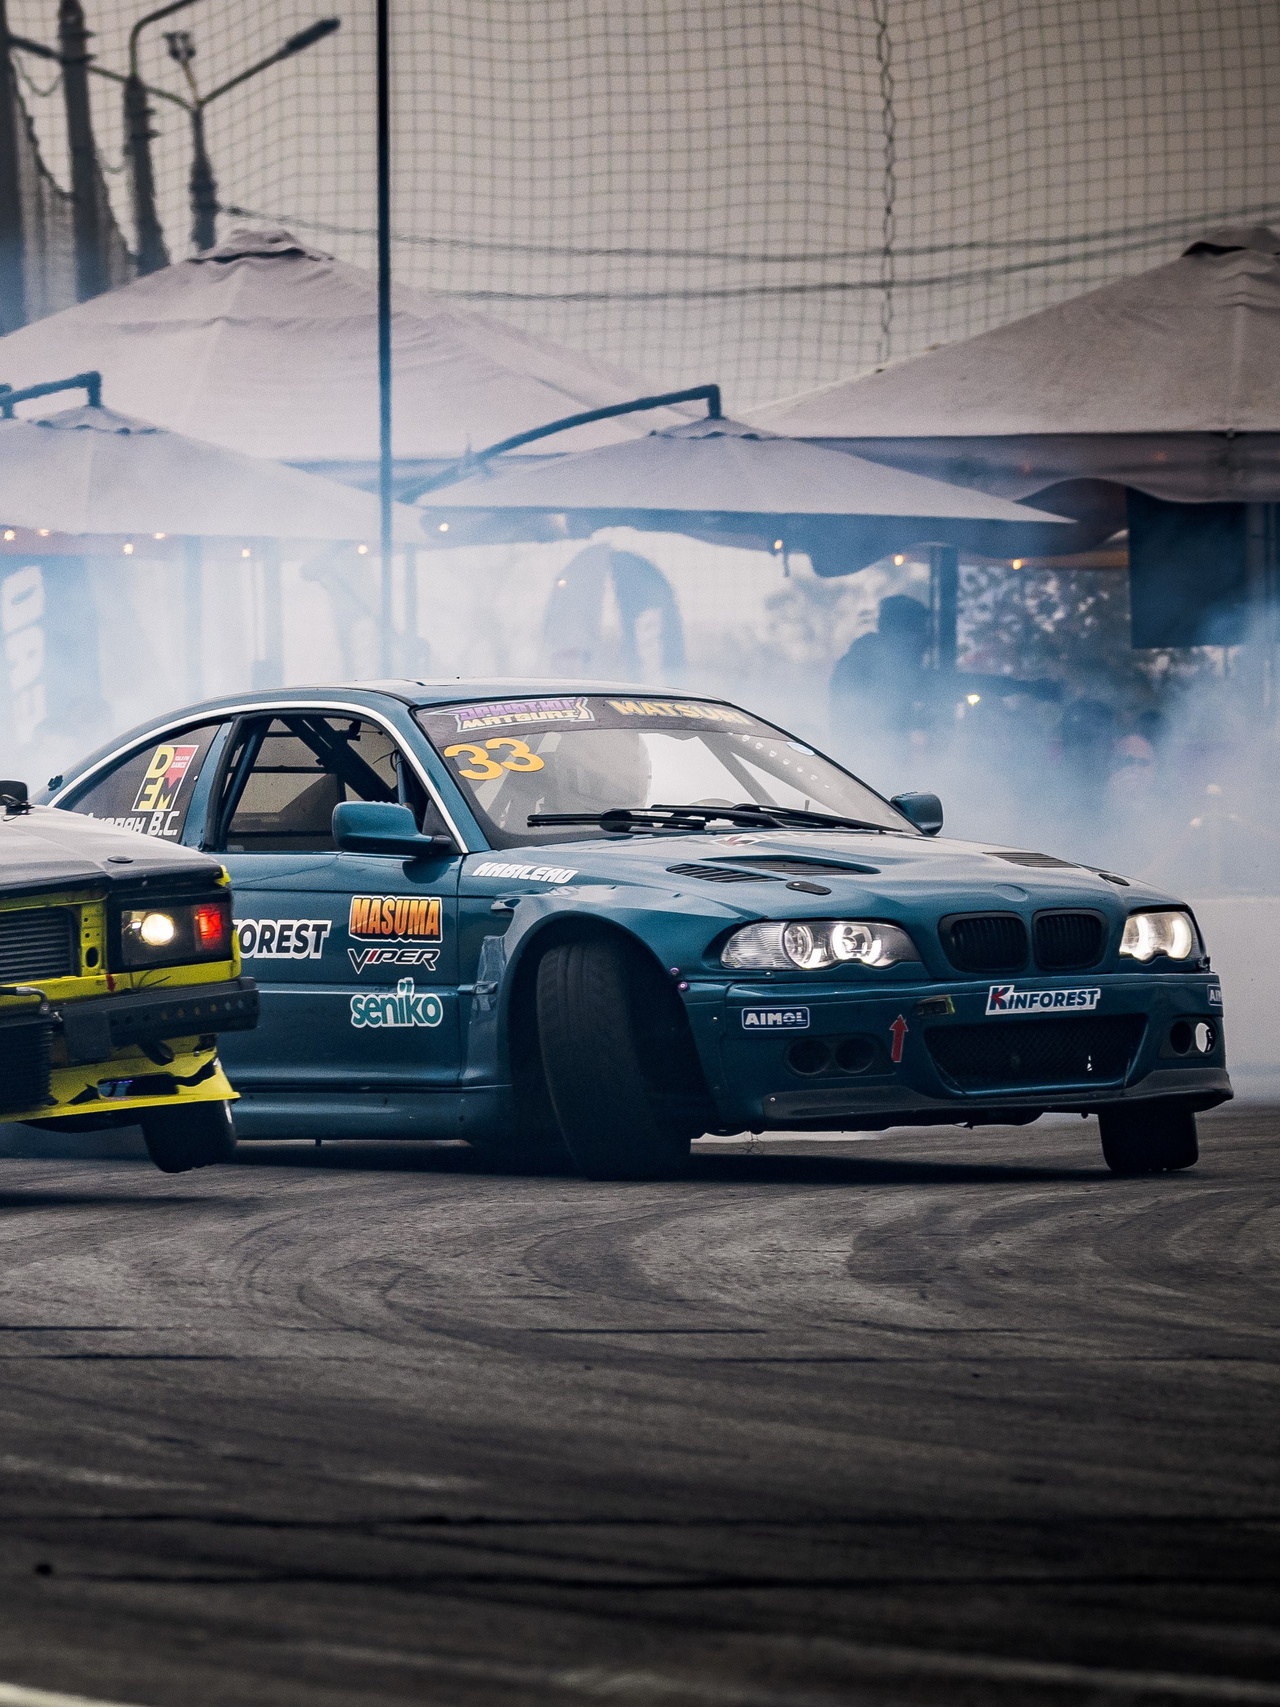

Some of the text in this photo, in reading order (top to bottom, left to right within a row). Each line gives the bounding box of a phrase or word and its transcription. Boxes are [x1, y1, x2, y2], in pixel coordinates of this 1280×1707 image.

[607, 700, 755, 727] MATSURI
[443, 738, 545, 780] 33
[472, 861, 579, 884] HABILEAD
[350, 897, 441, 942] MASUMA
[233, 922, 330, 956] OREST
[348, 949, 440, 974] VIPER
[351, 979, 442, 1026] seniko
[988, 986, 1099, 1011] KINFOREST
[744, 1012, 807, 1026] AIMOL
